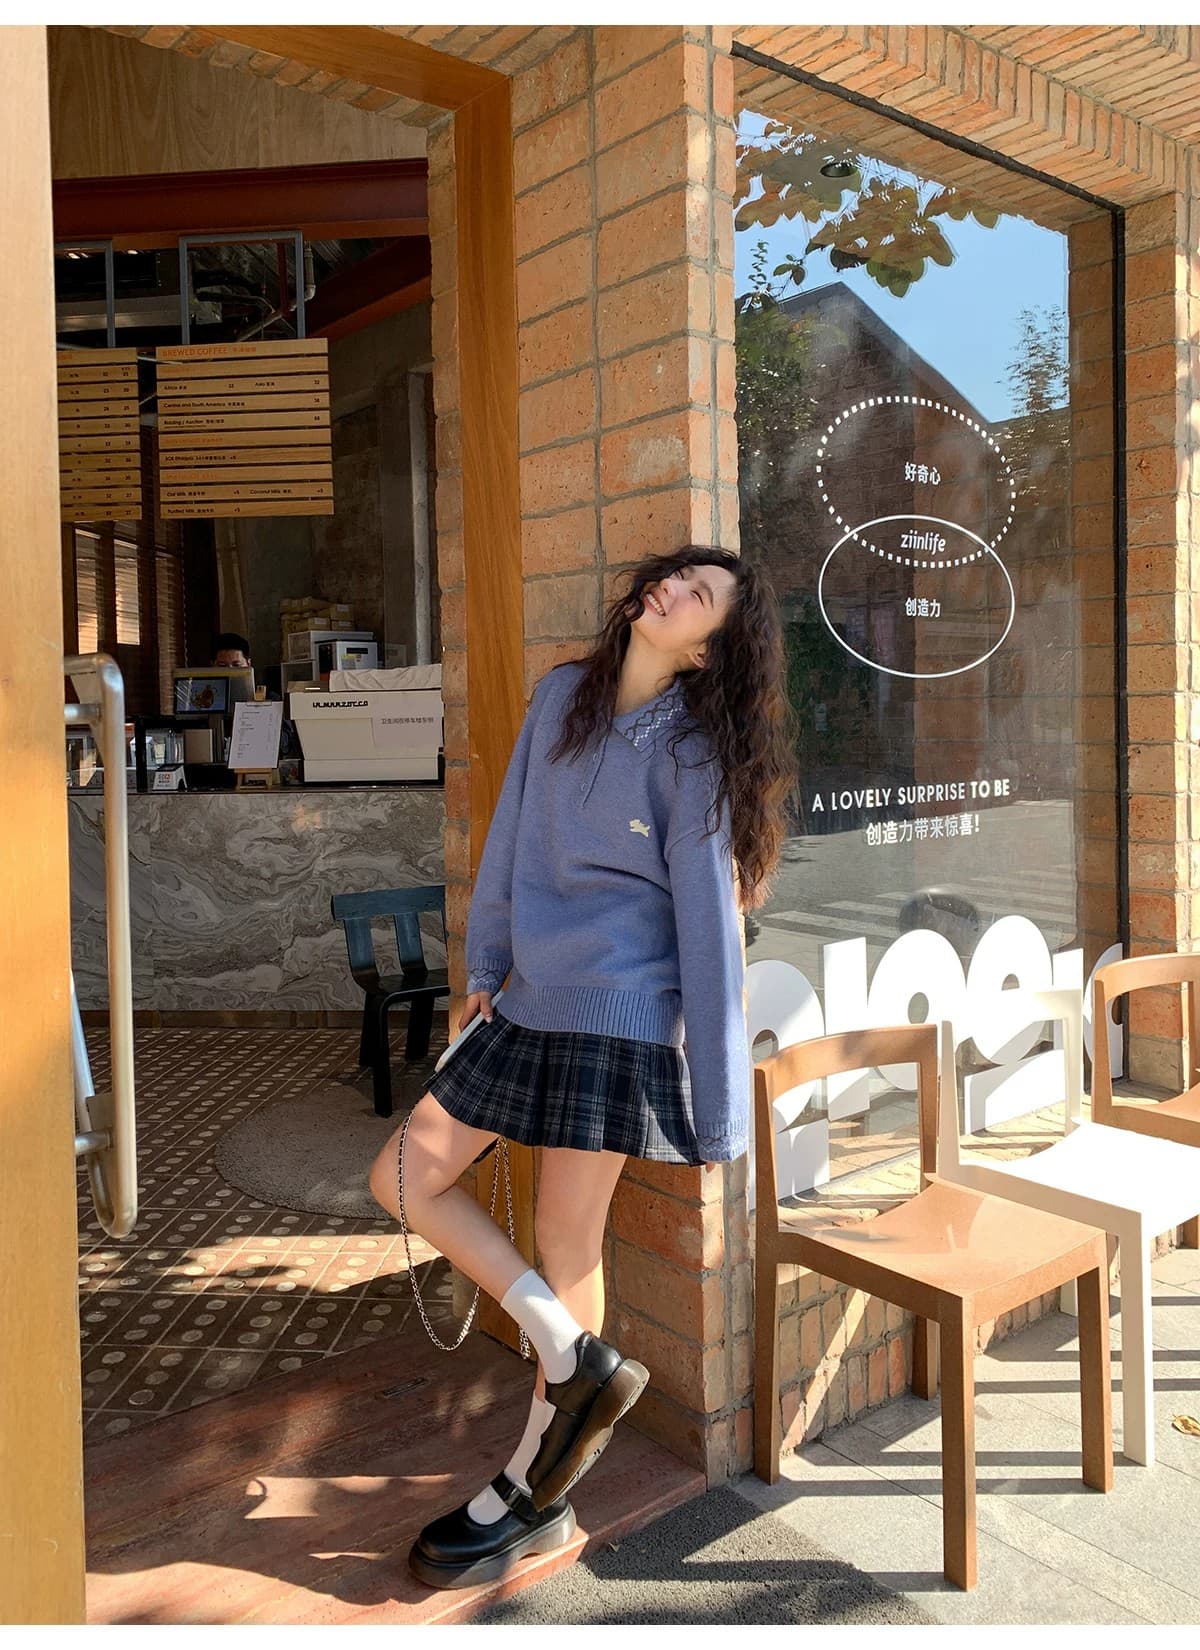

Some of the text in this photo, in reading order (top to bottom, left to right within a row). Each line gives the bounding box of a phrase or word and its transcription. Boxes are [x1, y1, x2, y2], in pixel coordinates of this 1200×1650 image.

[197, 346, 229, 356] COFFEE
[904, 462, 941, 486] 好奇心
[900, 529, 946, 554] ziinlife
[904, 597, 941, 618] 创造力
[811, 778, 1011, 812] A LOVELY SURPRISE TO BE
[865, 813, 980, 847] 创造力带来惊喜!
